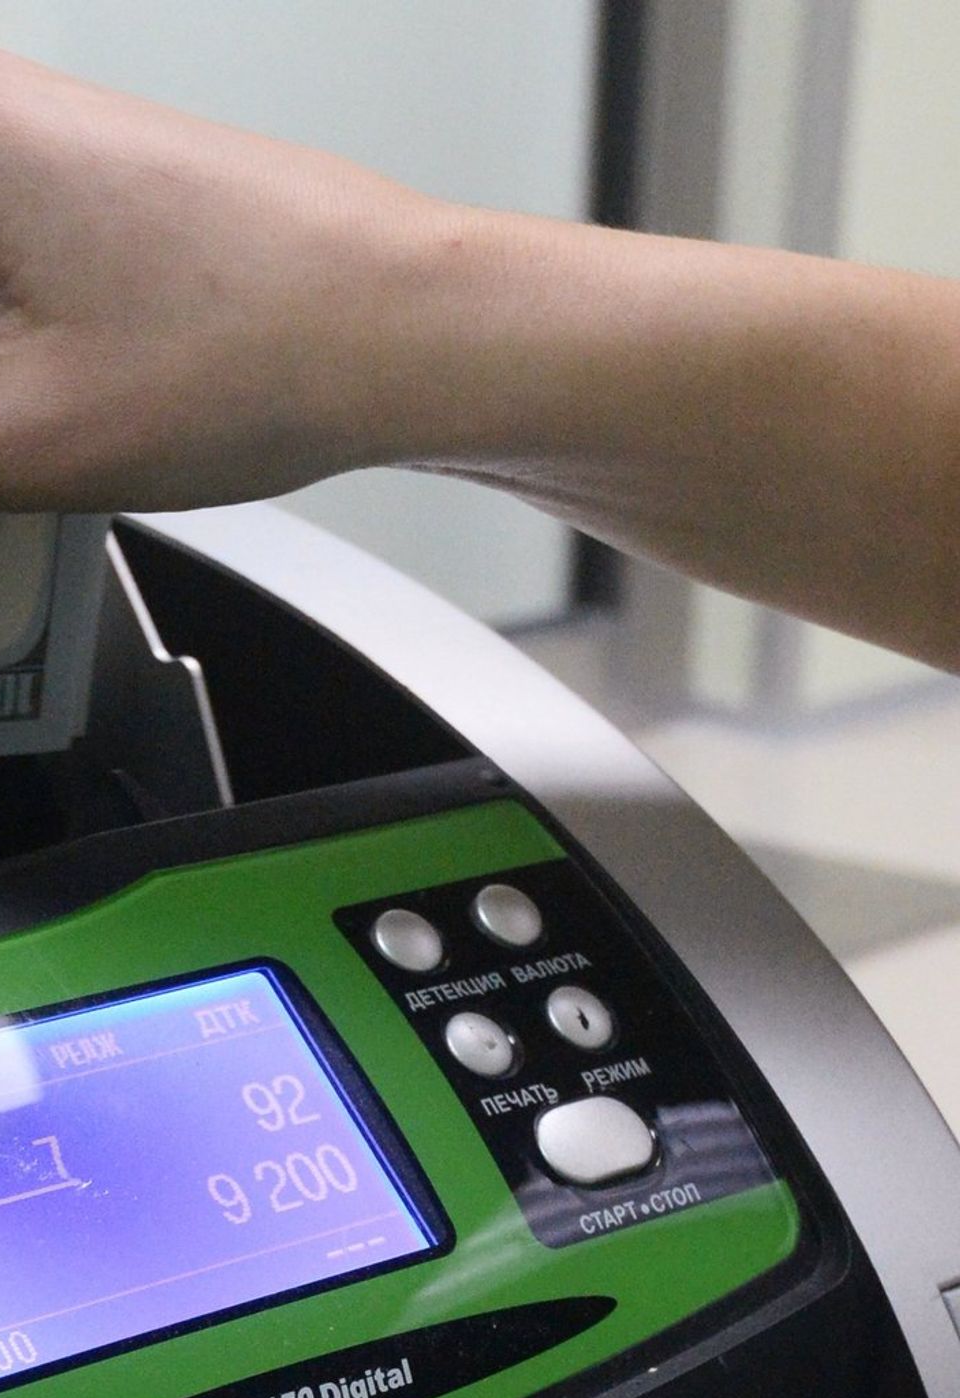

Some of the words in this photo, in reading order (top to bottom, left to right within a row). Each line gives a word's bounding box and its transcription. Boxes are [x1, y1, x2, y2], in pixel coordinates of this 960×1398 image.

[405, 971, 508, 1012] ДЕТЕКЦИЯ
[511, 951, 592, 984] ВАЛЮТА
[194, 999, 261, 1039] ДТК
[242, 1074, 322, 1132] 92
[481, 1082, 559, 1117] ПЕЧАТЬ
[580, 1056, 652, 1094] РЕЖИМ
